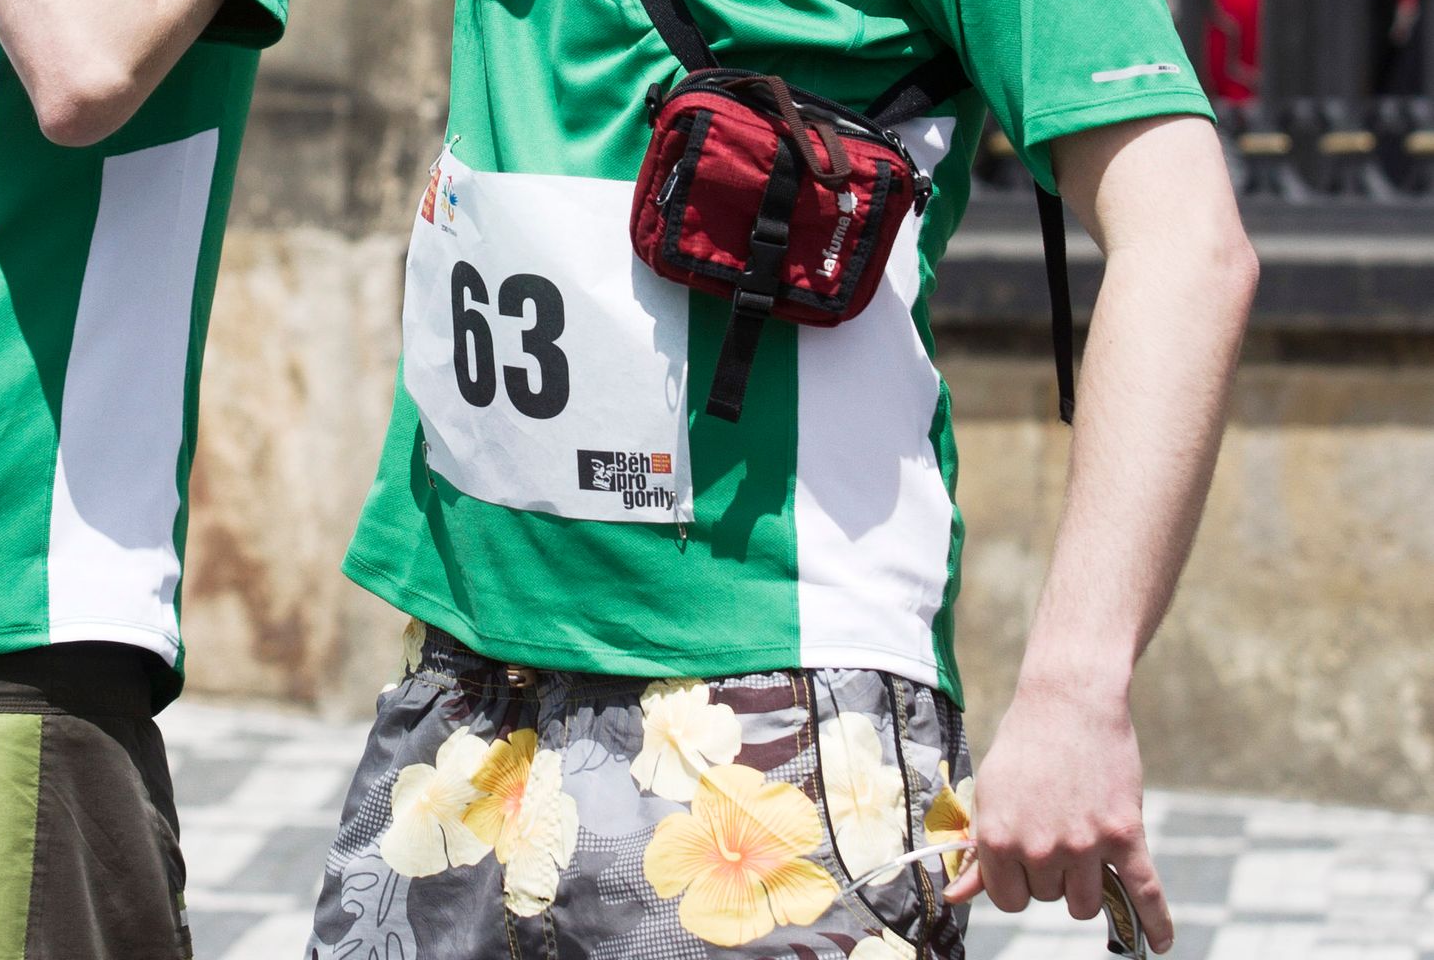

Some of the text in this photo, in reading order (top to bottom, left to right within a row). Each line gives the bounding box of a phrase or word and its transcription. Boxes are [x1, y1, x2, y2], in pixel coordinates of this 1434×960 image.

[815, 216, 852, 278] lafuma
[451, 260, 570, 420] 63
[615, 451, 651, 474] Běh
[616, 473, 646, 492] pro
[623, 486, 675, 510] gorily
